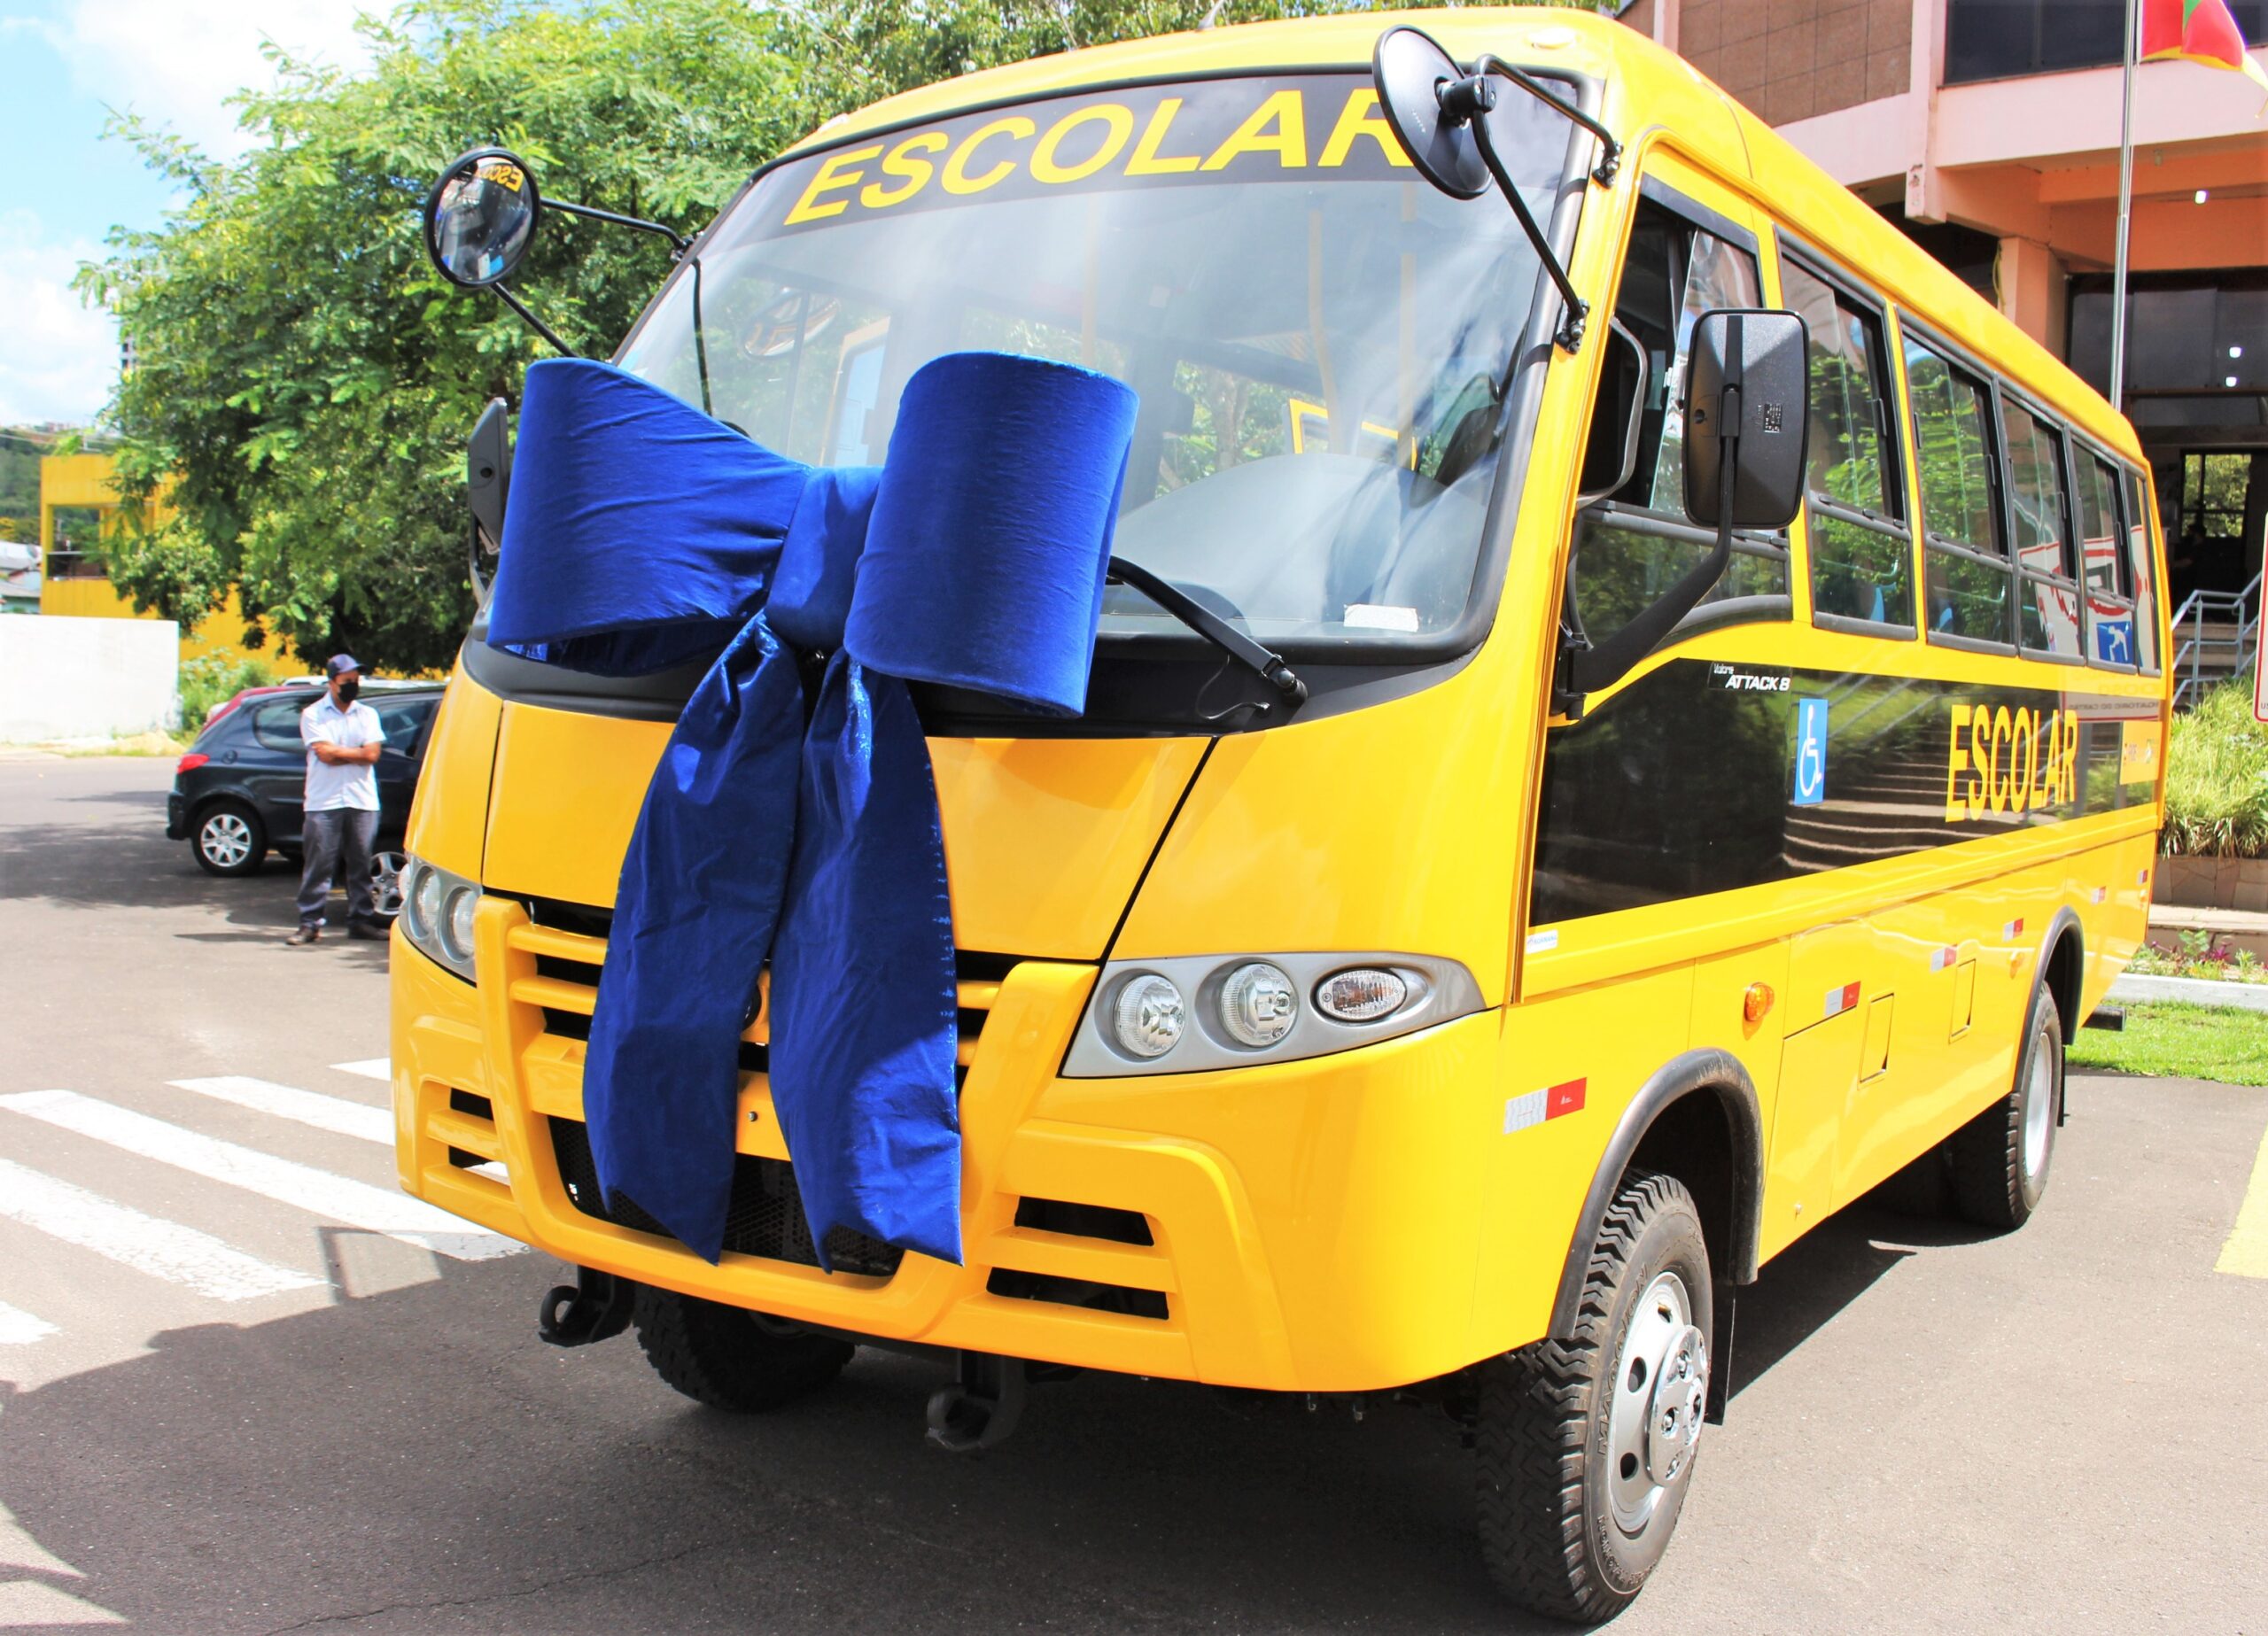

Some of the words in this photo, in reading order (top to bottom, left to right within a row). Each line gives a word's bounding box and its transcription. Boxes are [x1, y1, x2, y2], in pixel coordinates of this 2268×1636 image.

[784, 89, 1414, 227] ESCOLAR
[1725, 675, 1779, 690] ATTACK
[1779, 677, 1790, 691] 8
[1946, 704, 2078, 822] ESCOLAR
